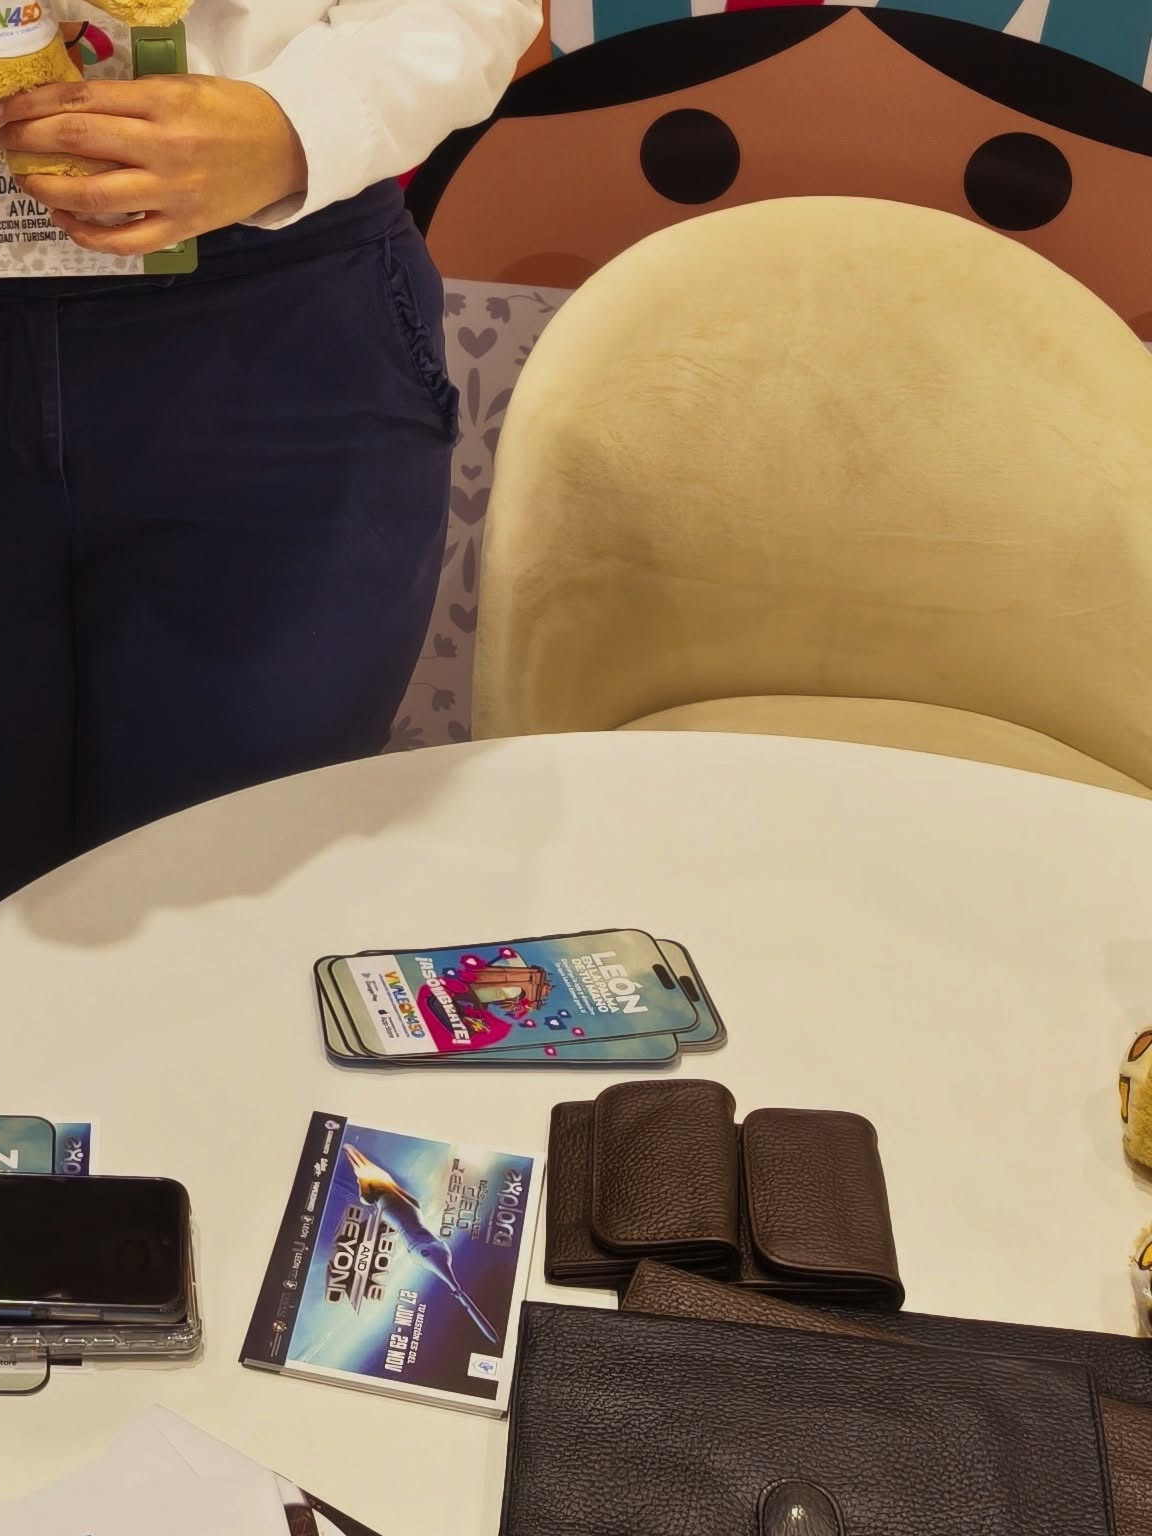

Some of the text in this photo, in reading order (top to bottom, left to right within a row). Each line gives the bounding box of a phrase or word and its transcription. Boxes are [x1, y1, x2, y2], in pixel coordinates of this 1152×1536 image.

[9, 199, 49, 217] AYAL
[22, 218, 56, 229] GENERA
[15, 232, 21, 243] Y
[22, 231, 57, 243] TURISMO
[571, 958, 609, 1013] DE TU MANO
[581, 955, 620, 1013] EN LA PALMA
[591, 951, 648, 1014] LEÓN
[325, 1206, 362, 1305] BEYOND
[356, 1244, 371, 1272] AND
[367, 1221, 398, 1303] ABOVE
[399, 1289, 418, 1305] 27
[394, 1304, 415, 1327] JUN
[384, 1349, 406, 1373] NOV
